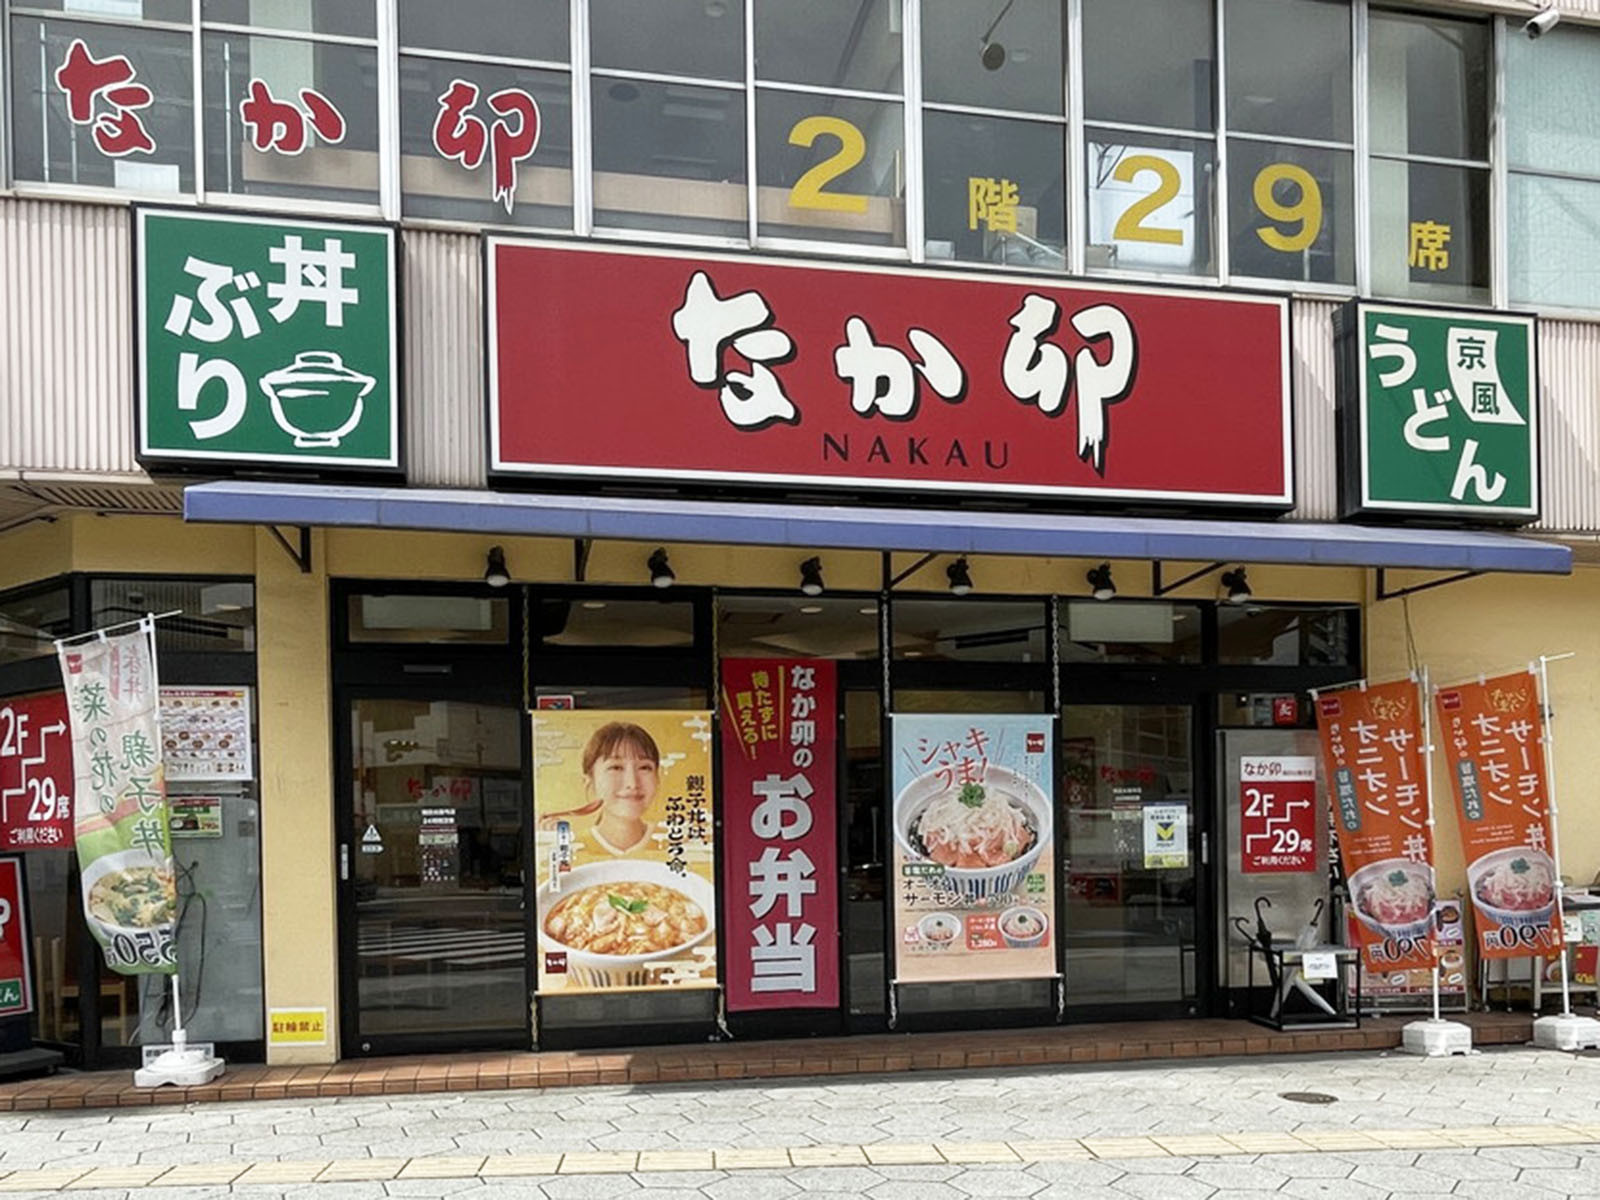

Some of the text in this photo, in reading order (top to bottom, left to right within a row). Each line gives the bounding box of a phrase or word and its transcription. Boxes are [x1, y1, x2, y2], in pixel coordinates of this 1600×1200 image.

[55, 39, 541, 215] なか卯
[671, 270, 1137, 477] なか卯
[1455, 336, 1501, 416] 京風
[1368, 323, 1507, 503] うどん
[822, 432, 1010, 470] NAKAU
[918, 728, 990, 765] シャキ
[1244, 762, 1282, 777] なか卯
[1244, 788, 1275, 818] 2F
[1271, 828, 1313, 854] 29席
[1252, 855, 1306, 866] ご利用ください
